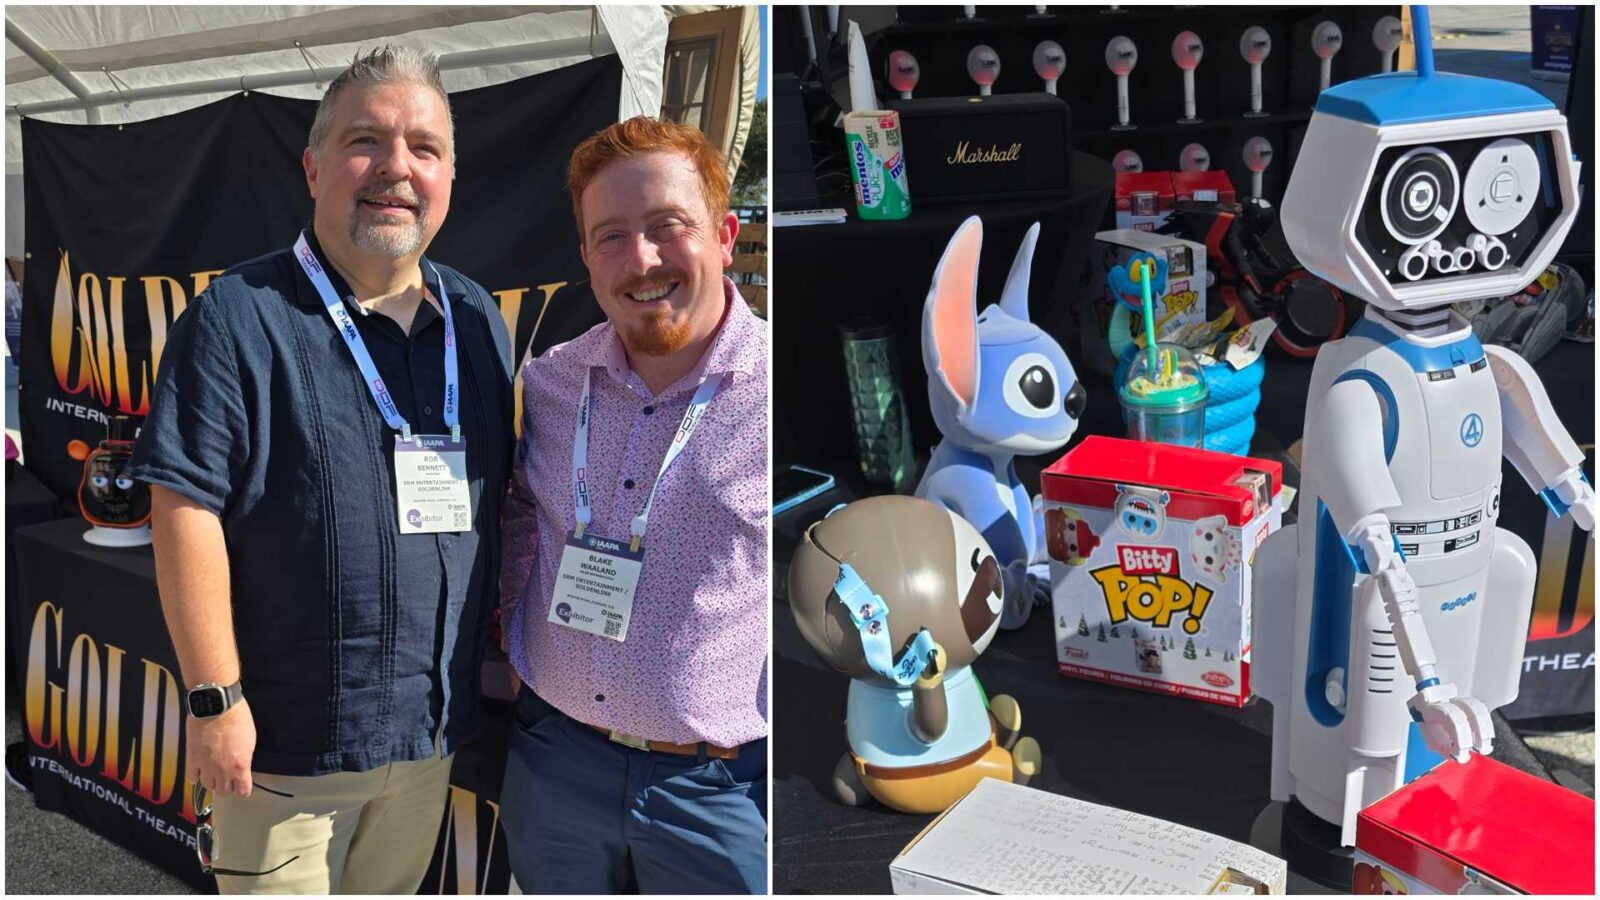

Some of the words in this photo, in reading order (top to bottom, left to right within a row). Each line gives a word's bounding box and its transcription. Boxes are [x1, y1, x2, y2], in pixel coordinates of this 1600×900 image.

[947, 141, 1022, 165] Marshall
[855, 142, 871, 205] mentos
[301, 246, 321, 274] DOF
[51, 248, 224, 416] GOLD
[373, 378, 398, 417] DOF
[675, 403, 696, 443] DOF
[576, 468, 589, 507] DOF
[589, 555, 613, 566] BLAKE
[597, 540, 620, 551] IAAPA
[1123, 549, 1172, 573] Bitty
[575, 576, 624, 594] ENTERTAINMENT
[580, 562, 617, 576] WAALAND
[1089, 565, 1214, 635] POP!
[26, 600, 213, 826] GOLD
